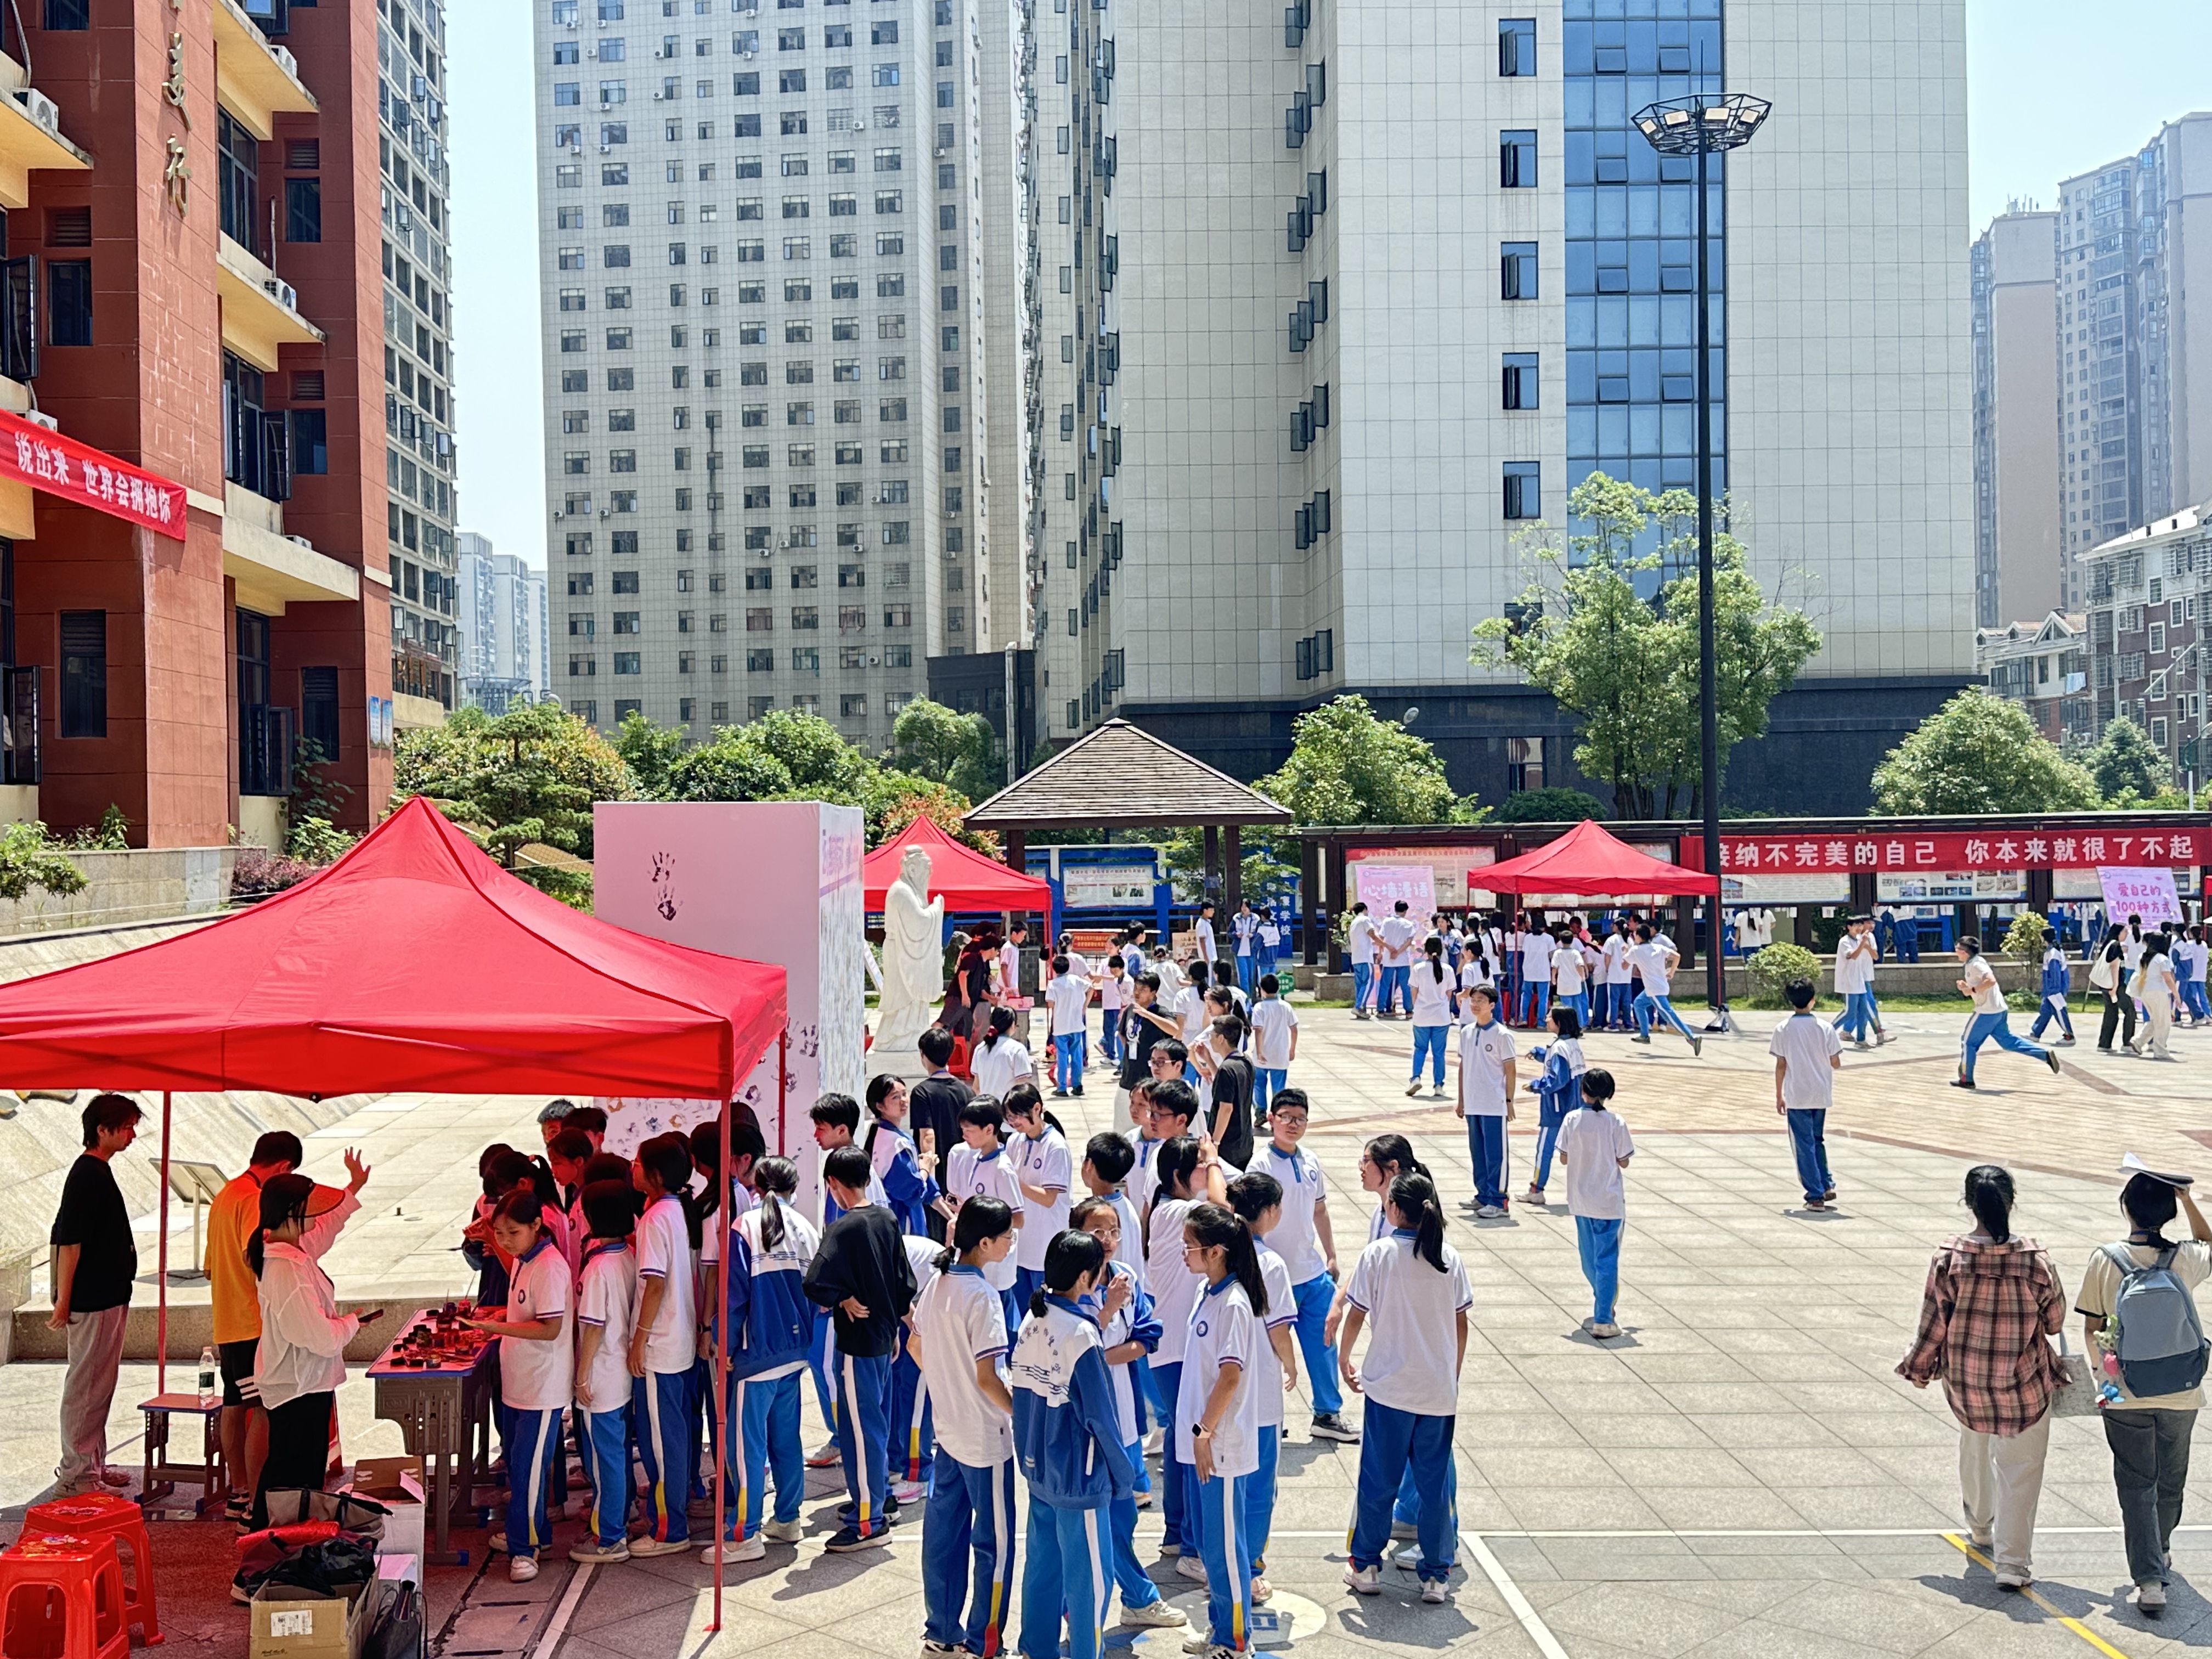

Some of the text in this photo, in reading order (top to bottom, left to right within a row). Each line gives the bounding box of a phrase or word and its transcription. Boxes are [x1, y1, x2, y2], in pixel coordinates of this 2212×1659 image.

[15, 430, 171, 524] 说出来 世界会拥抱你
[1965, 835, 2193, 864] 你本来就很了不起
[1363, 881, 1429, 899] 心墙漫语
[2118, 882, 2162, 897] 爱自己的
[2116, 900, 2172, 914] 100种方式
